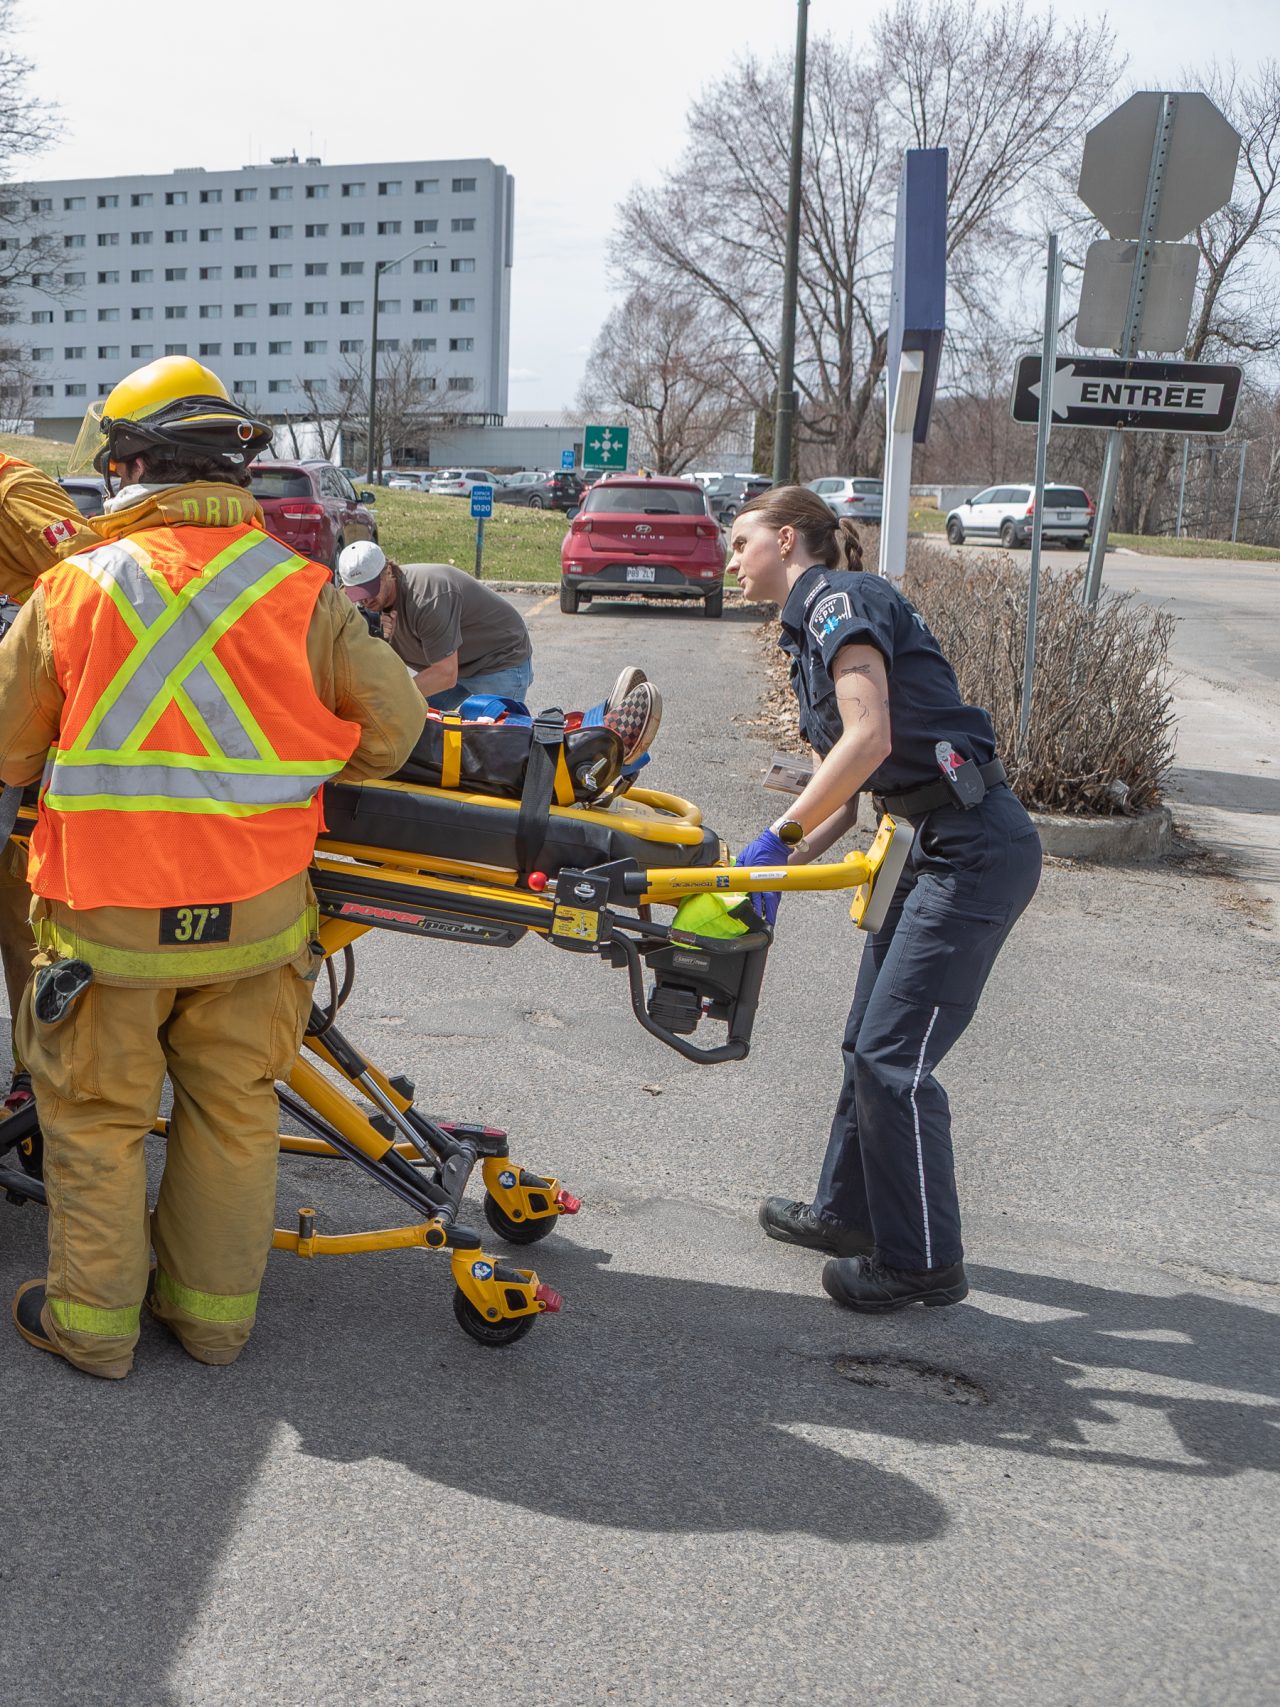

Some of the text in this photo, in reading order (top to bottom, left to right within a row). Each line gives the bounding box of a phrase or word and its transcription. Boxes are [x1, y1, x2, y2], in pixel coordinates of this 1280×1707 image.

[472, 504, 491, 512] 1020
[819, 605, 835, 624] SPU
[339, 902, 426, 925] power
[423, 919, 463, 933] pro
